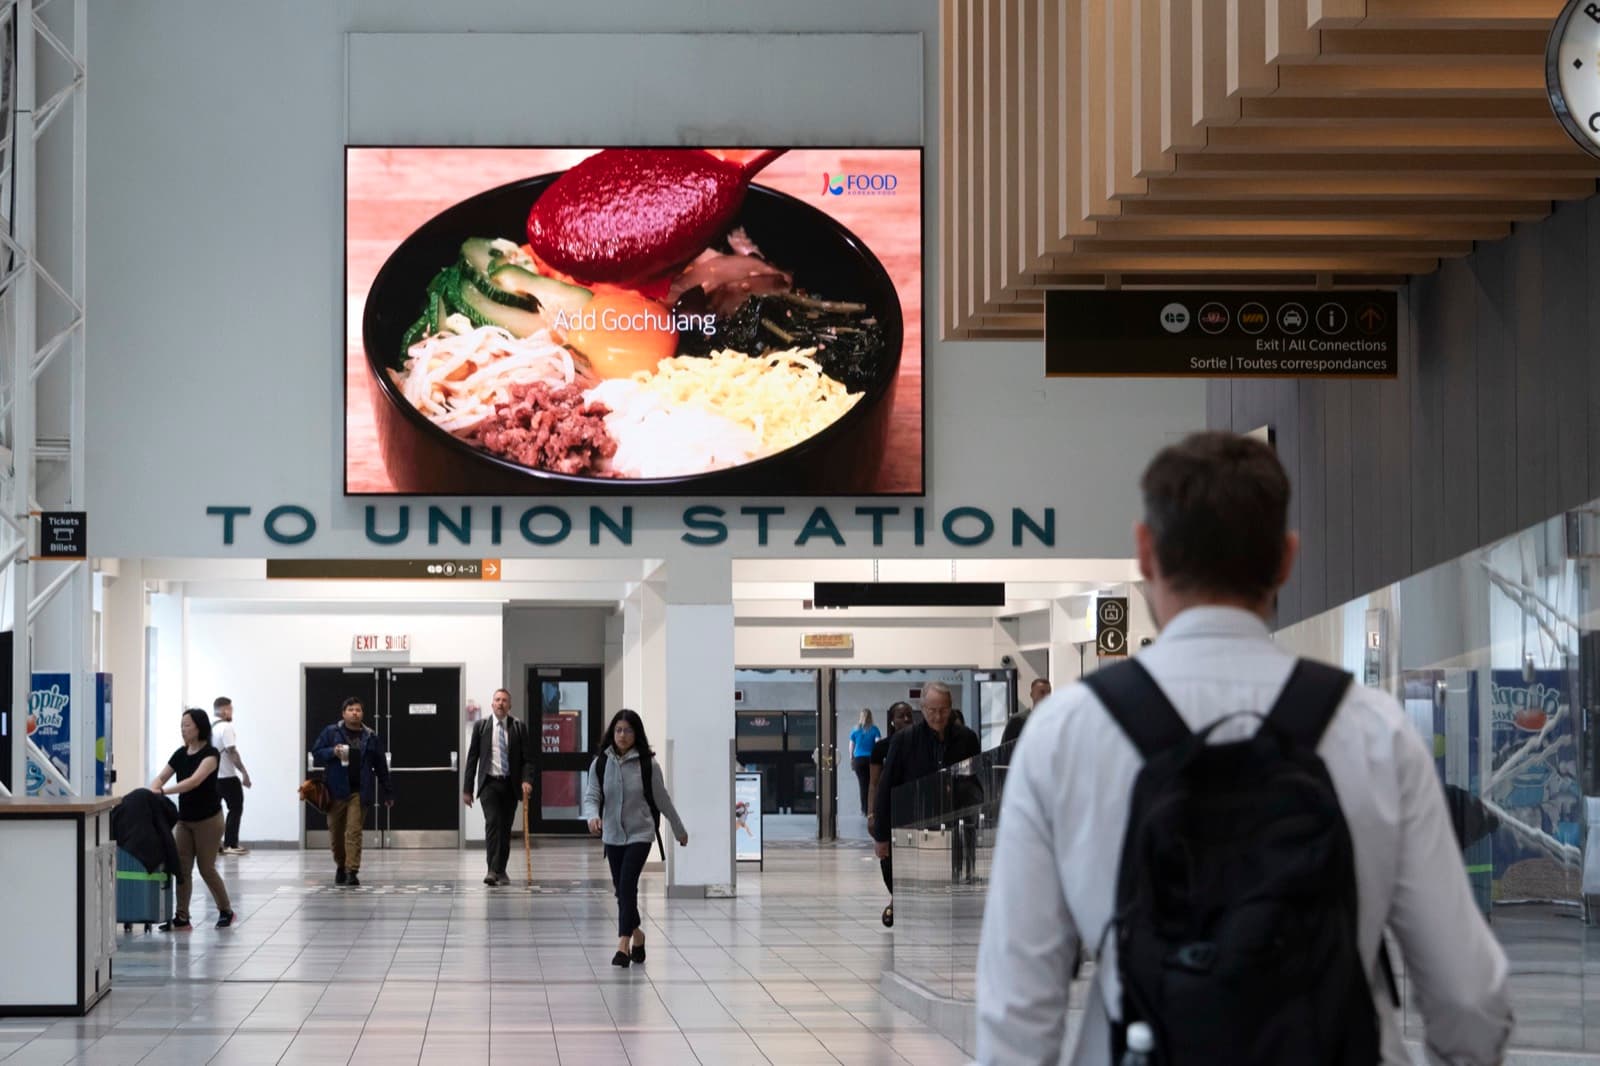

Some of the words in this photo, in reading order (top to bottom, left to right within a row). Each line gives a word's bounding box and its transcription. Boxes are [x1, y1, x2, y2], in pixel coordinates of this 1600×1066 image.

[847, 174, 898, 191] FOOD
[553, 308, 596, 331] Add
[601, 307, 717, 336] Gochujang
[1256, 338, 1280, 351] Exit
[1288, 338, 1307, 351] All
[1309, 338, 1387, 351] Connections
[1190, 356, 1227, 369] Sortie
[1236, 356, 1278, 369] Toutes
[1280, 356, 1387, 372] correspondances
[48, 517, 80, 526] Tickets
[206, 505, 317, 545] TO
[365, 505, 633, 546] UNION
[681, 505, 1056, 546] STATION
[50, 543, 78, 552] Billets
[356, 635, 379, 650] EXIT
